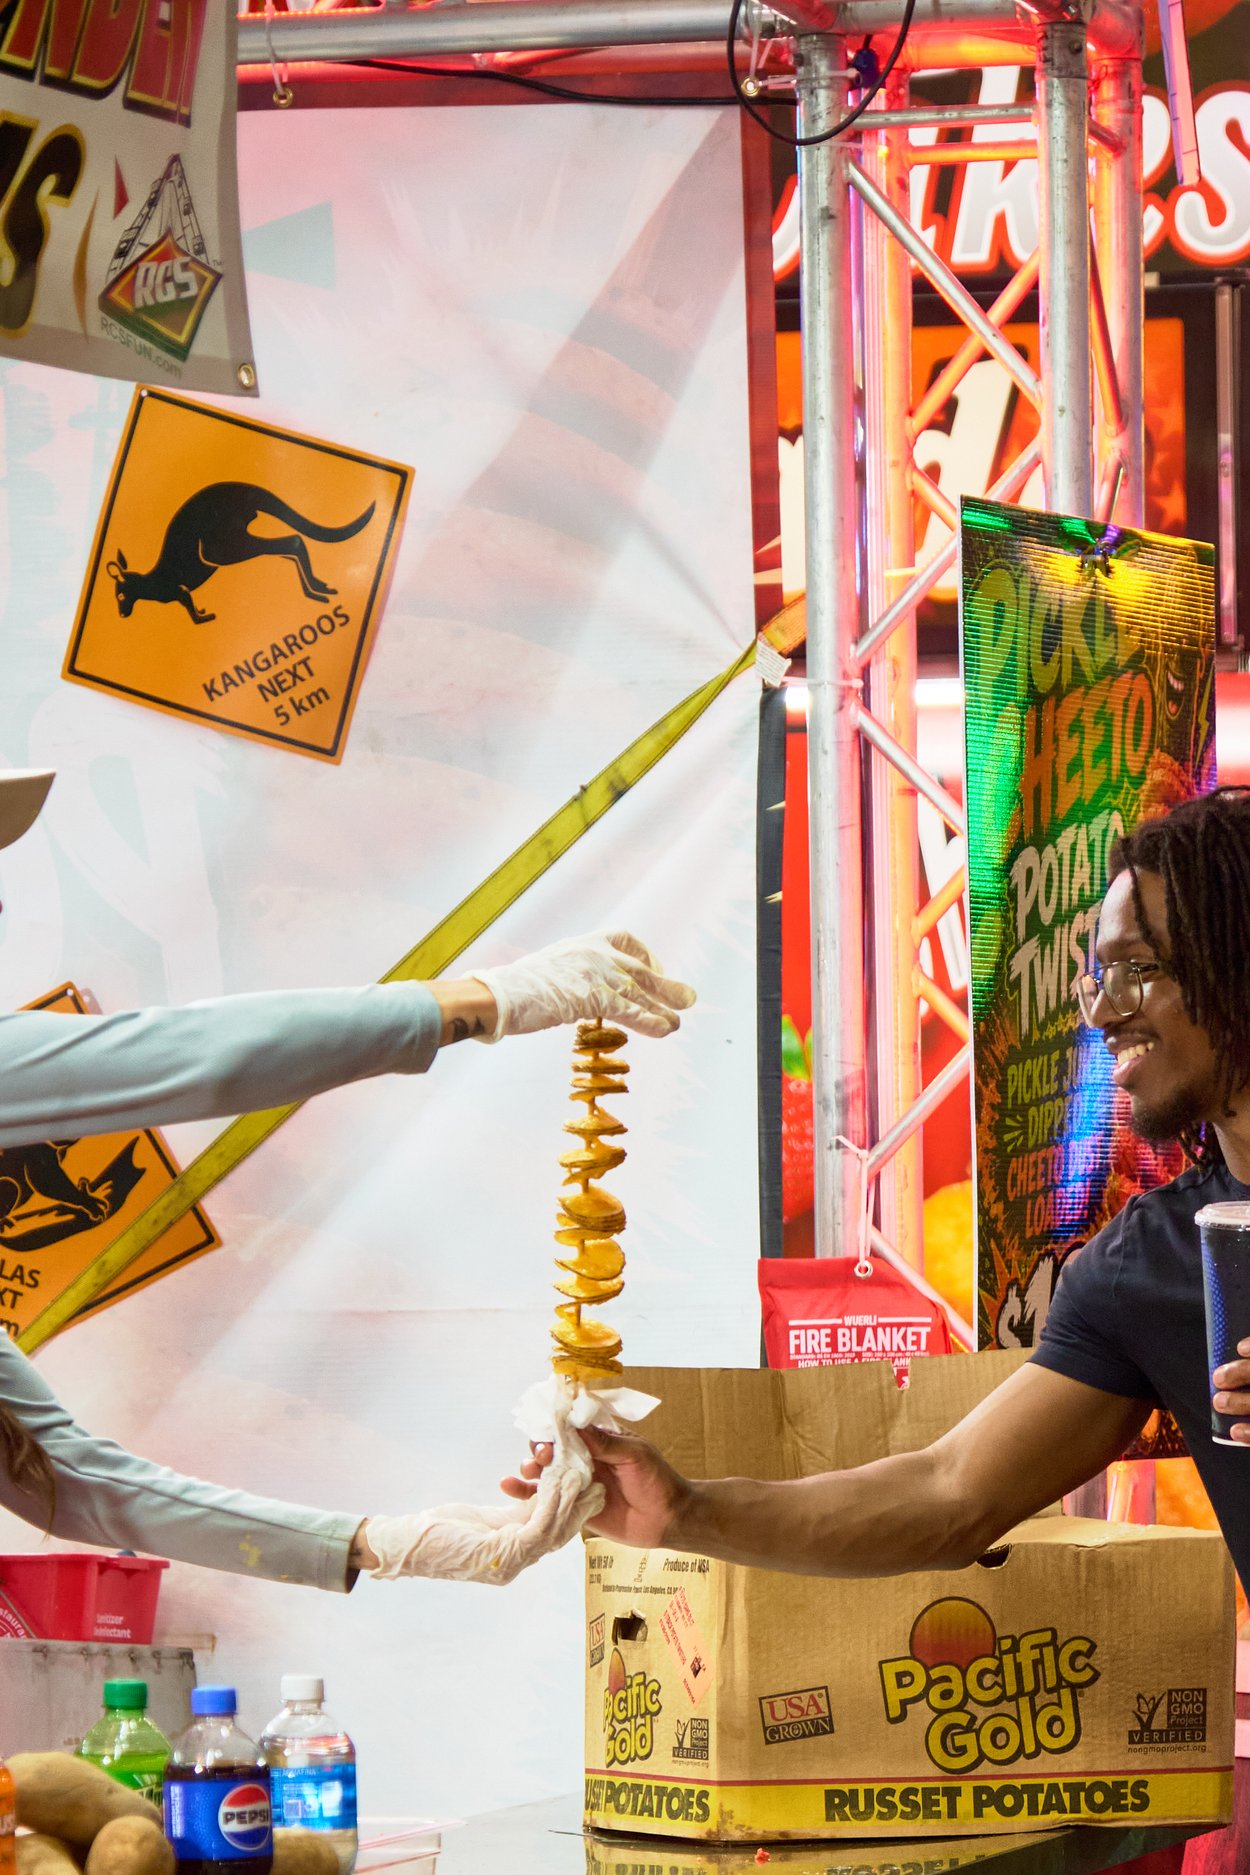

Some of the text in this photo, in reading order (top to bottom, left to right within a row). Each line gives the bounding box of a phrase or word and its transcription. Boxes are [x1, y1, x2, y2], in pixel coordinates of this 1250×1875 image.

[134, 256, 199, 309] RCS
[202, 604, 350, 702] KANGAROOS
[257, 656, 315, 703] NEXT
[273, 686, 331, 726] 5 km
[1006, 1049, 1060, 1108] PICKLE
[844, 1315, 877, 1326] WUERLI
[789, 1326, 931, 1355] FIRE BLANKET
[798, 1359, 819, 1369] HOW
[663, 1558, 690, 1573] Produce
[690, 1559, 697, 1572] of
[697, 1559, 710, 1573] USA
[879, 1627, 1100, 1724] Pacific
[1171, 1690, 1204, 1702] NON
[766, 1693, 826, 1722] USA
[1170, 1702, 1204, 1715] GMO
[692, 1718, 708, 1729] NON
[766, 1717, 831, 1742] GROWN
[925, 1688, 1082, 1774] Gold
[1170, 1715, 1203, 1727] Project
[692, 1729, 708, 1739] GMO
[1132, 1730, 1203, 1743] VERIFIED
[674, 1748, 708, 1759] VERIFIED
[1127, 1743, 1207, 1756] nongmoproject.org
[605, 1780, 710, 1823] POTATOES
[824, 1780, 1150, 1823] RUSSET POTATOES
[223, 1811, 270, 1825] PEPSI
